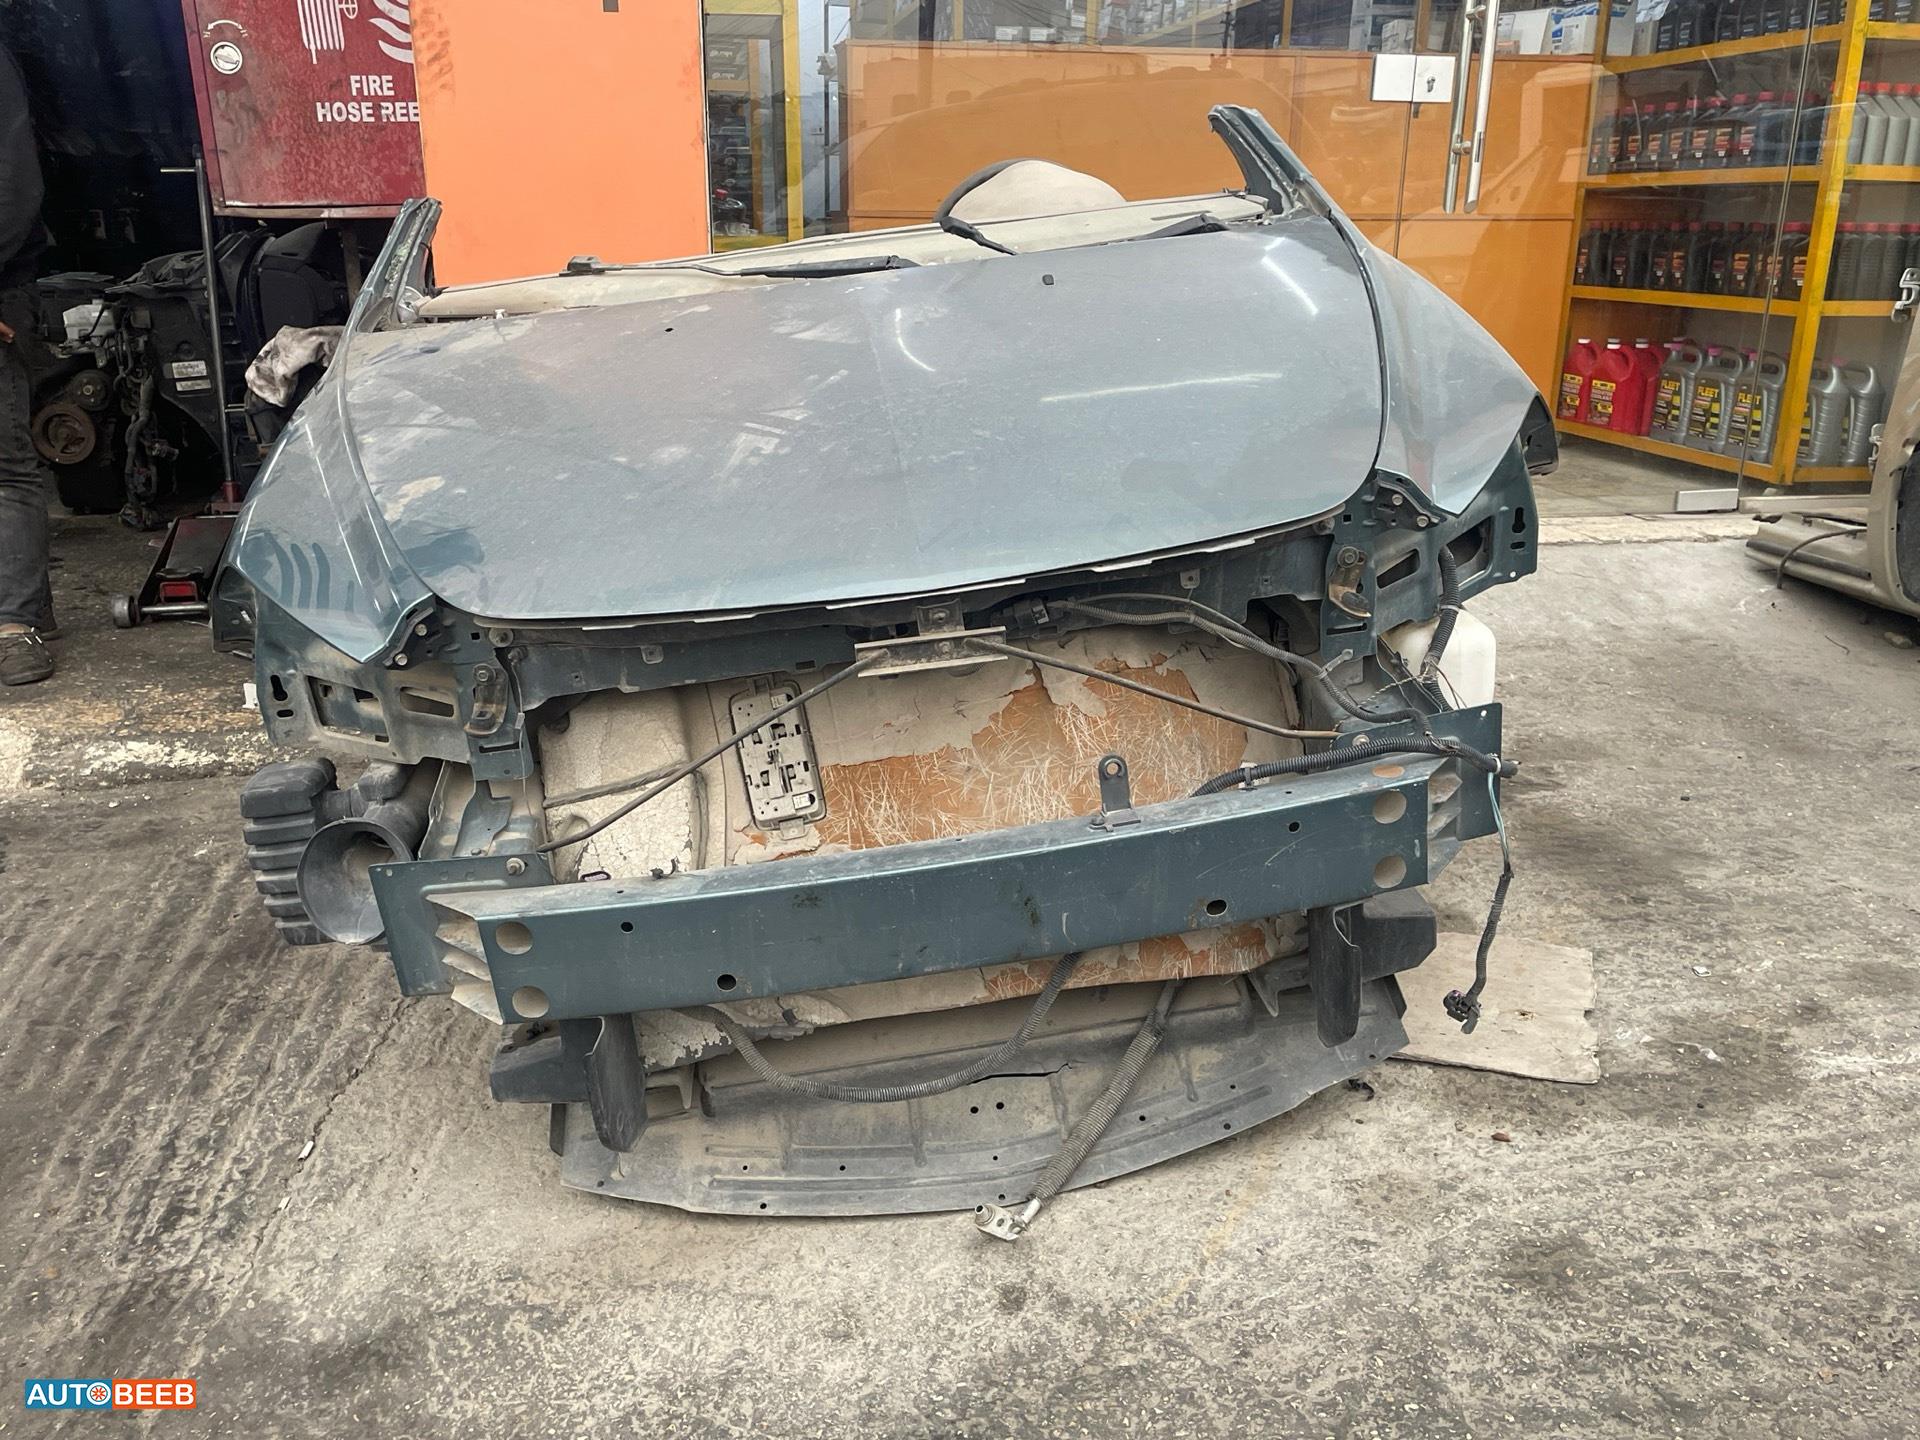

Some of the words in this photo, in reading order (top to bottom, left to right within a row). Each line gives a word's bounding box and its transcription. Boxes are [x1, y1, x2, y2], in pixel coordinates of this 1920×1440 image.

[349, 74, 395, 96] FIRE
[315, 101, 375, 122] HOSE
[380, 101, 419, 122] REE
[1660, 379, 1680, 391] FLEET
[1697, 386, 1719, 398] FLEET
